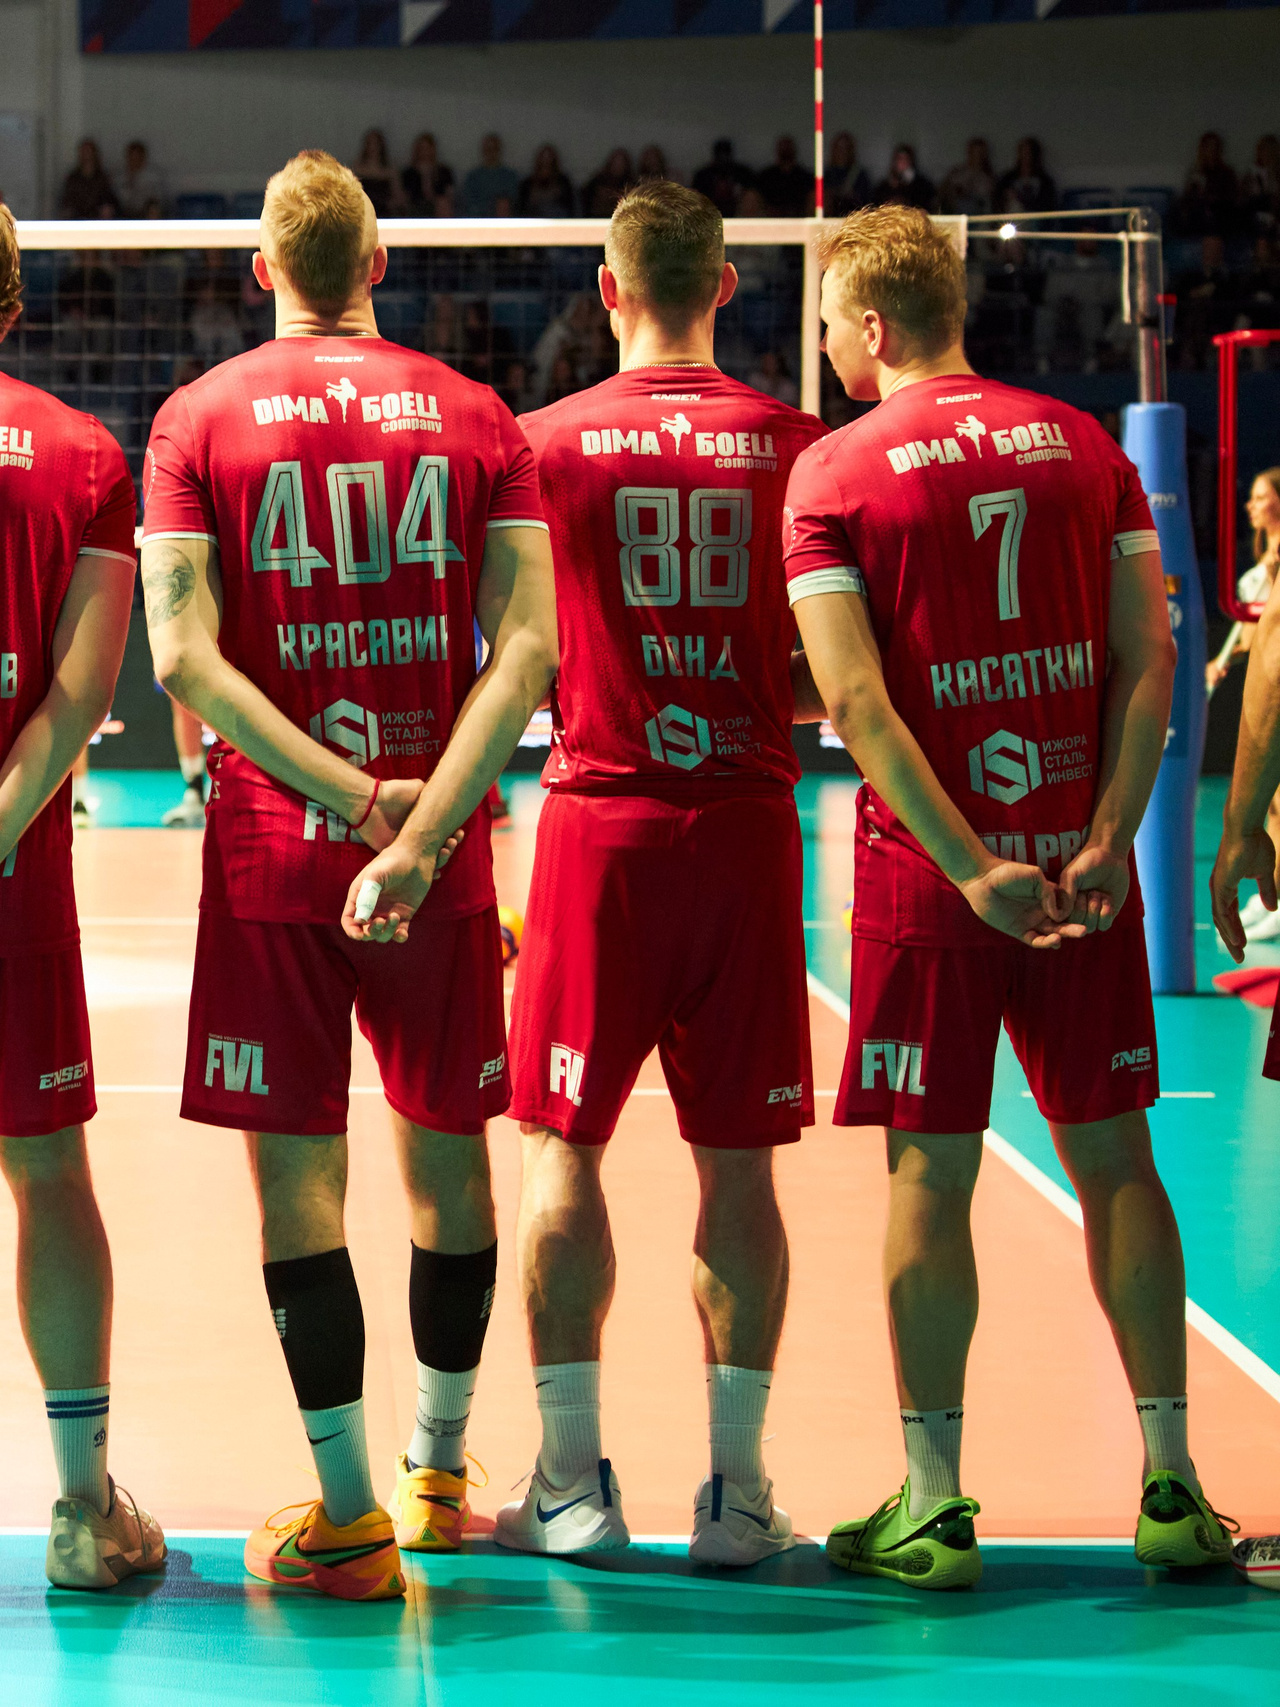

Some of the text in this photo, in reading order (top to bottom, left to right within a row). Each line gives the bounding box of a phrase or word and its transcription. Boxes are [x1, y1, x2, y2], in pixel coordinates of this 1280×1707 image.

[252, 391, 442, 425] DIMA БОЕЦ
[381, 419, 442, 434] company
[581, 428, 778, 458] DIMA БОЕЦ
[886, 421, 1070, 475] DIMA БОЕЦ
[714, 457, 778, 472] company
[1015, 445, 1072, 466] company
[251, 455, 466, 588] 404
[614, 486, 753, 607] 88
[968, 487, 1028, 621] 7
[641, 634, 740, 682] БОНД
[381, 708, 435, 724] ИЖОРА
[383, 725, 430, 740] СТАЛЬ
[1042, 733, 1088, 753] ИЖОРА
[384, 739, 440, 756] ИНВЕСТ
[1044, 751, 1086, 769] СТАЛЬ
[1047, 764, 1093, 785] ИНВЕСТ
[205, 1037, 269, 1096] FVL
[861, 1043, 926, 1096] FVL
[1111, 1046, 1151, 1072] ENS
[767, 1083, 802, 1104] ENS
